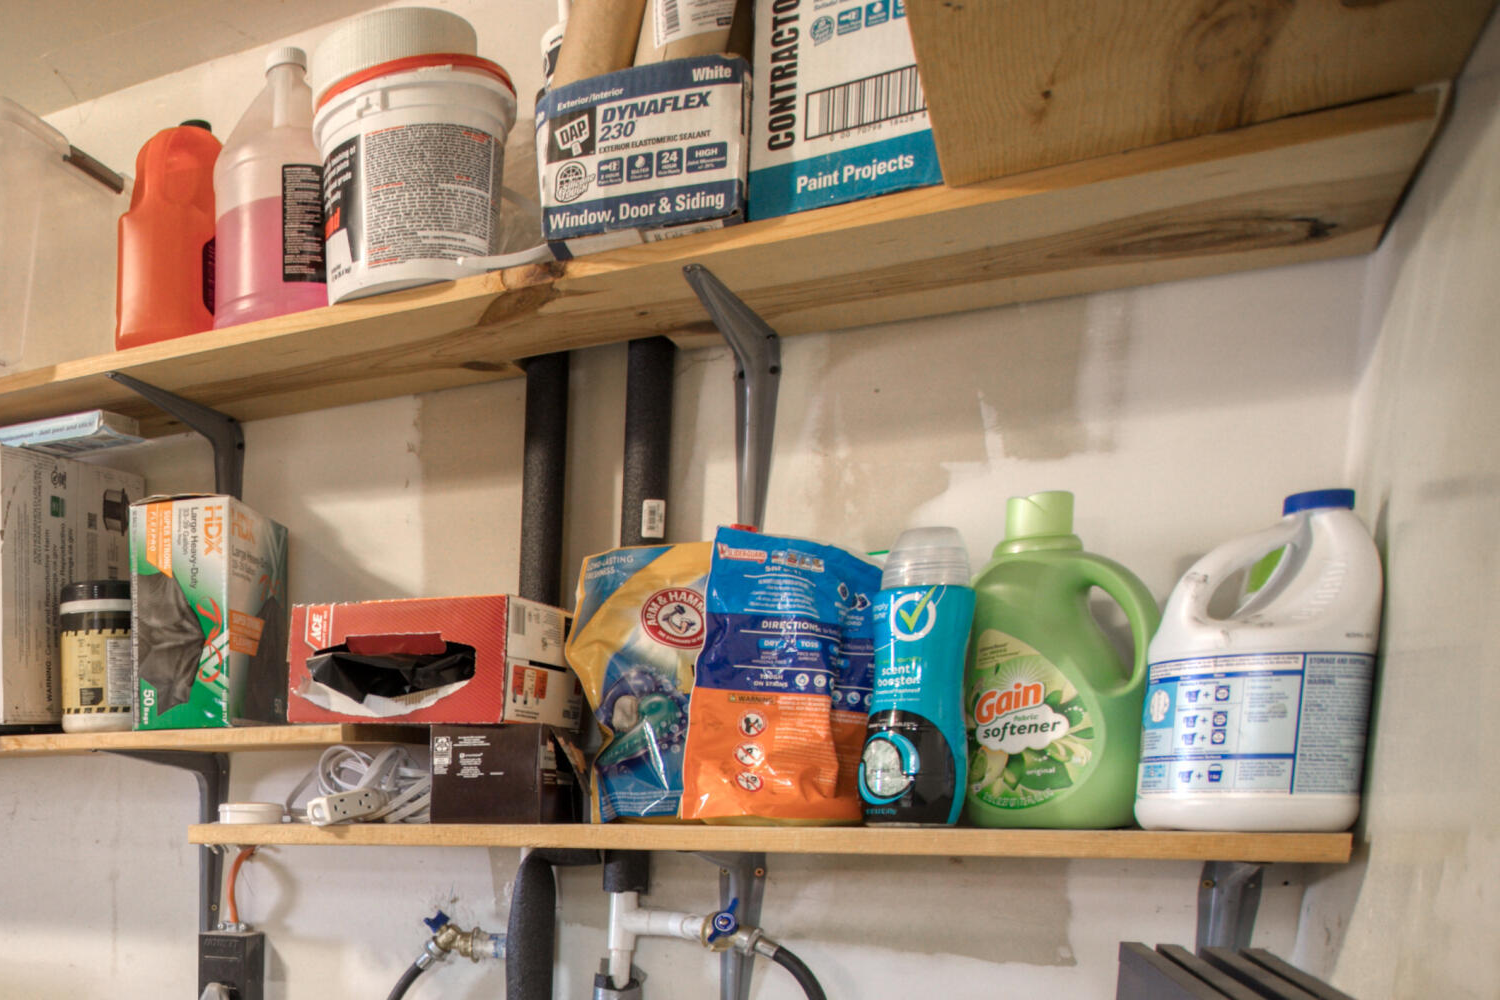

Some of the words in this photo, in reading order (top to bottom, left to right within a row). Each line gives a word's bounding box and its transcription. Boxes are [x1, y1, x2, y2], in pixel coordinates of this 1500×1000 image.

[692, 65, 732, 82] White
[557, 87, 624, 111] Exterior/Interior
[601, 90, 712, 123] DYNAFLEX
[559, 119, 588, 146] DAP
[598, 120, 635, 143] 230
[598, 142, 631, 154] EXTERIOR
[679, 130, 711, 141] SEALANT
[661, 151, 678, 164] 24
[695, 148, 718, 158] HIGH
[796, 172, 840, 194] Paint
[843, 154, 915, 184] Projects
[549, 208, 616, 233] Window,
[619, 202, 656, 220] Door
[658, 197, 672, 214] &
[675, 191, 725, 212] Siding
[163, 510, 172, 534] SUPER
[190, 506, 199, 533] Large
[204, 505, 223, 556] HDX
[163, 537, 172, 570] STRONG
[189, 534, 199, 590] Heavy-Duty
[646, 601, 659, 626] ARM
[658, 595, 668, 606] &
[310, 613, 323, 642] ACE
[801, 640, 819, 648] TOSS
[881, 664, 911, 676] scent
[143, 689, 154, 706] 50
[975, 683, 1043, 724] Gain
[983, 720, 1062, 742] softener
[1025, 766, 1056, 777] original
